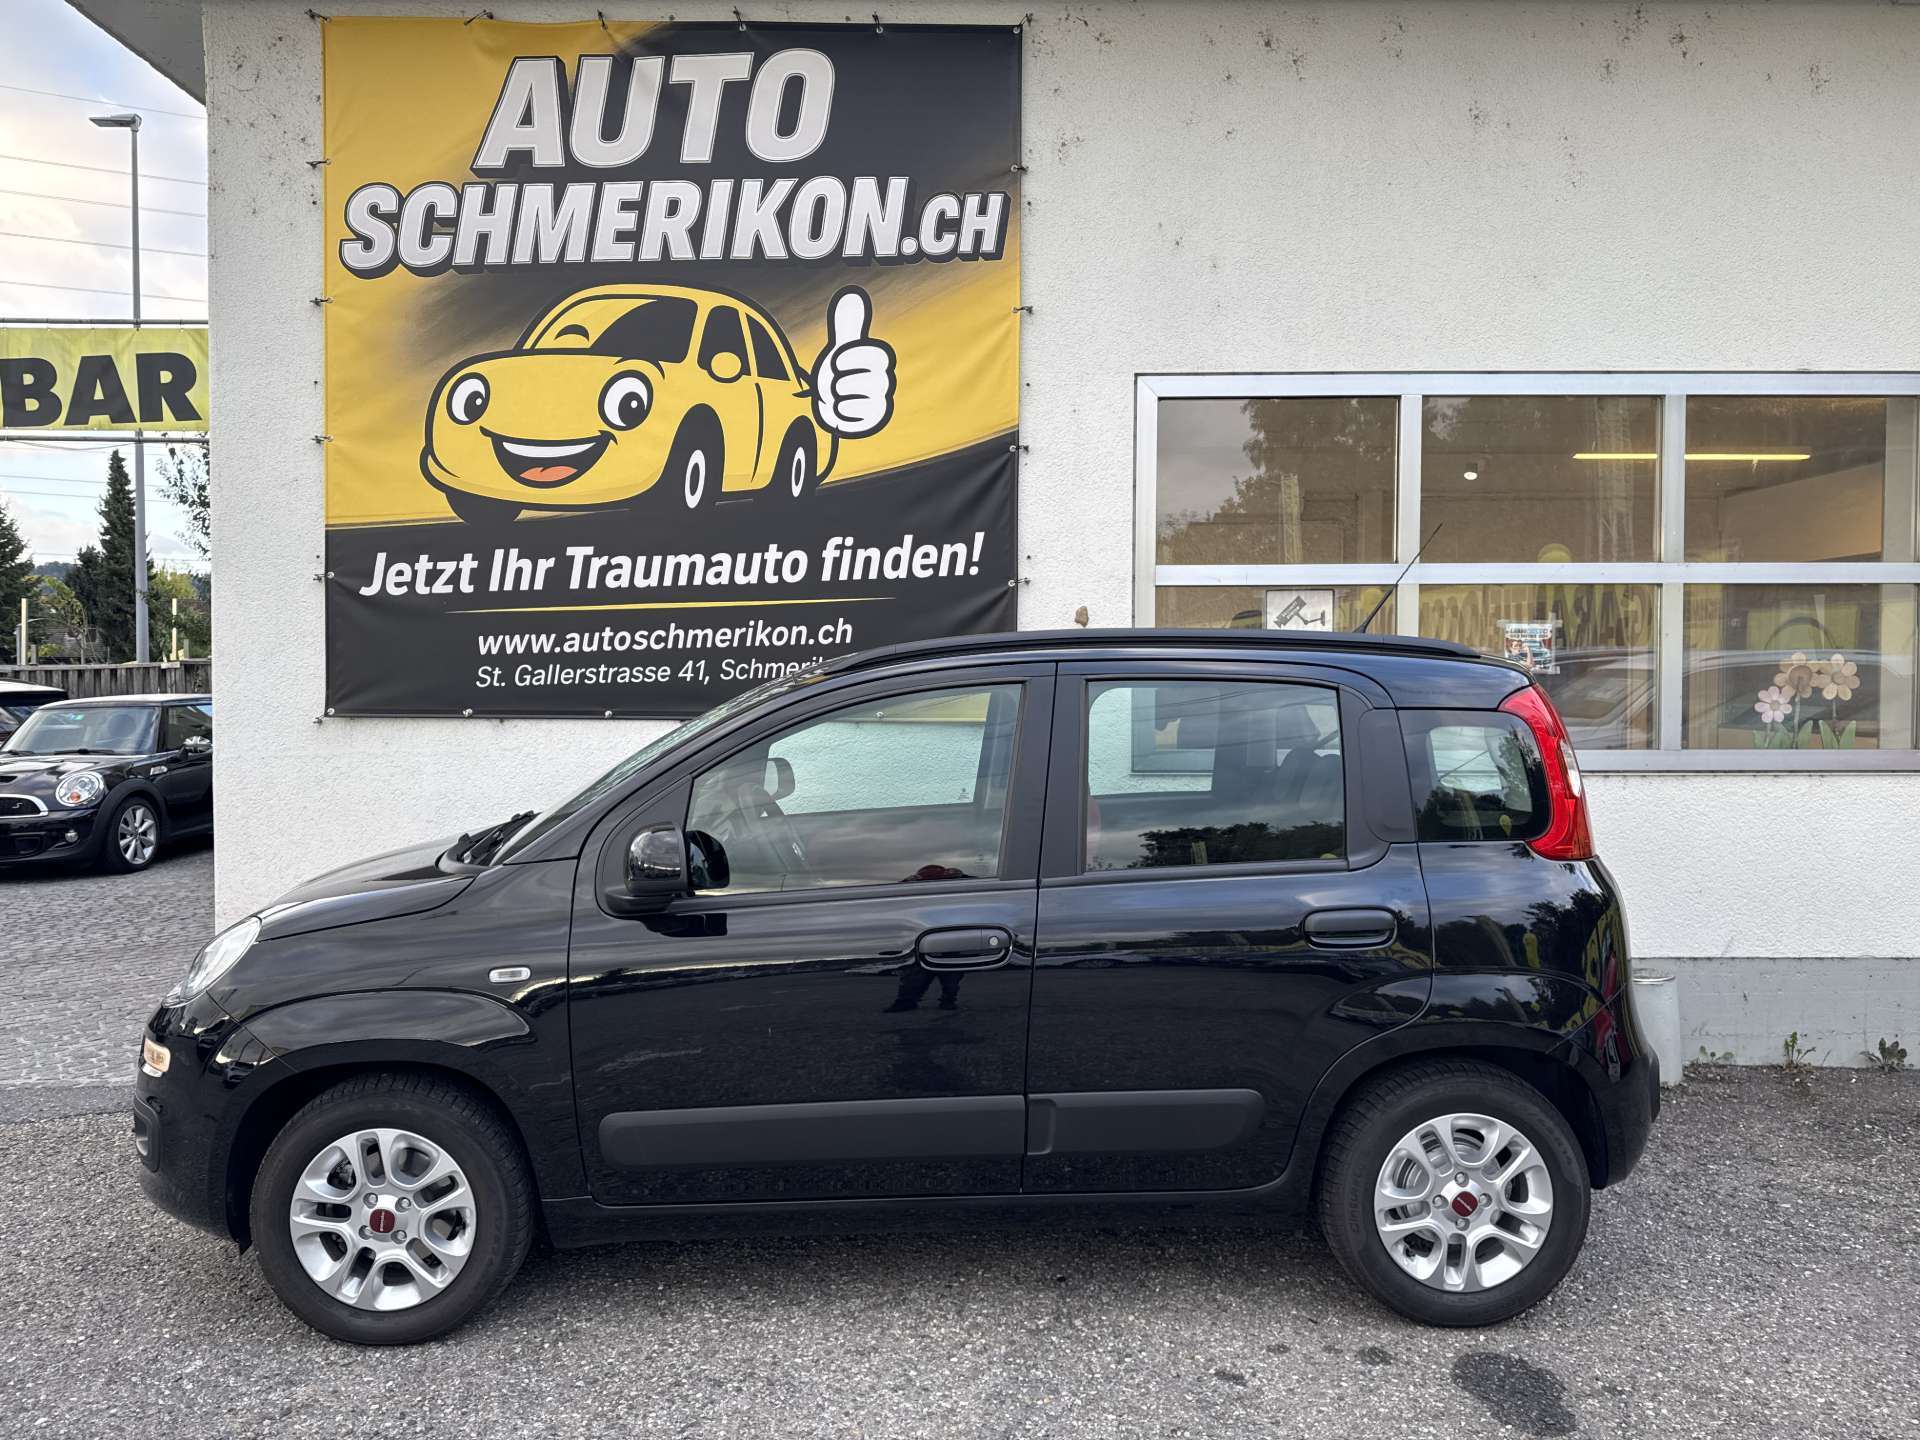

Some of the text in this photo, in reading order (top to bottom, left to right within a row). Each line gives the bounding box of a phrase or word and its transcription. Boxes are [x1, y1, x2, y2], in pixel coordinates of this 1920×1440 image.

[473, 48, 836, 169] AUTO
[341, 176, 1006, 269] SCHMERIKON.CH
[0, 352, 203, 428] BAR
[359, 531, 985, 597] Jetzt Ihr Traumauto finden!
[478, 617, 854, 656] www.autoschmerikon.ch
[475, 664, 506, 688] St.
[514, 662, 671, 687] Gallerstrasse
[677, 659, 710, 685] 41,
